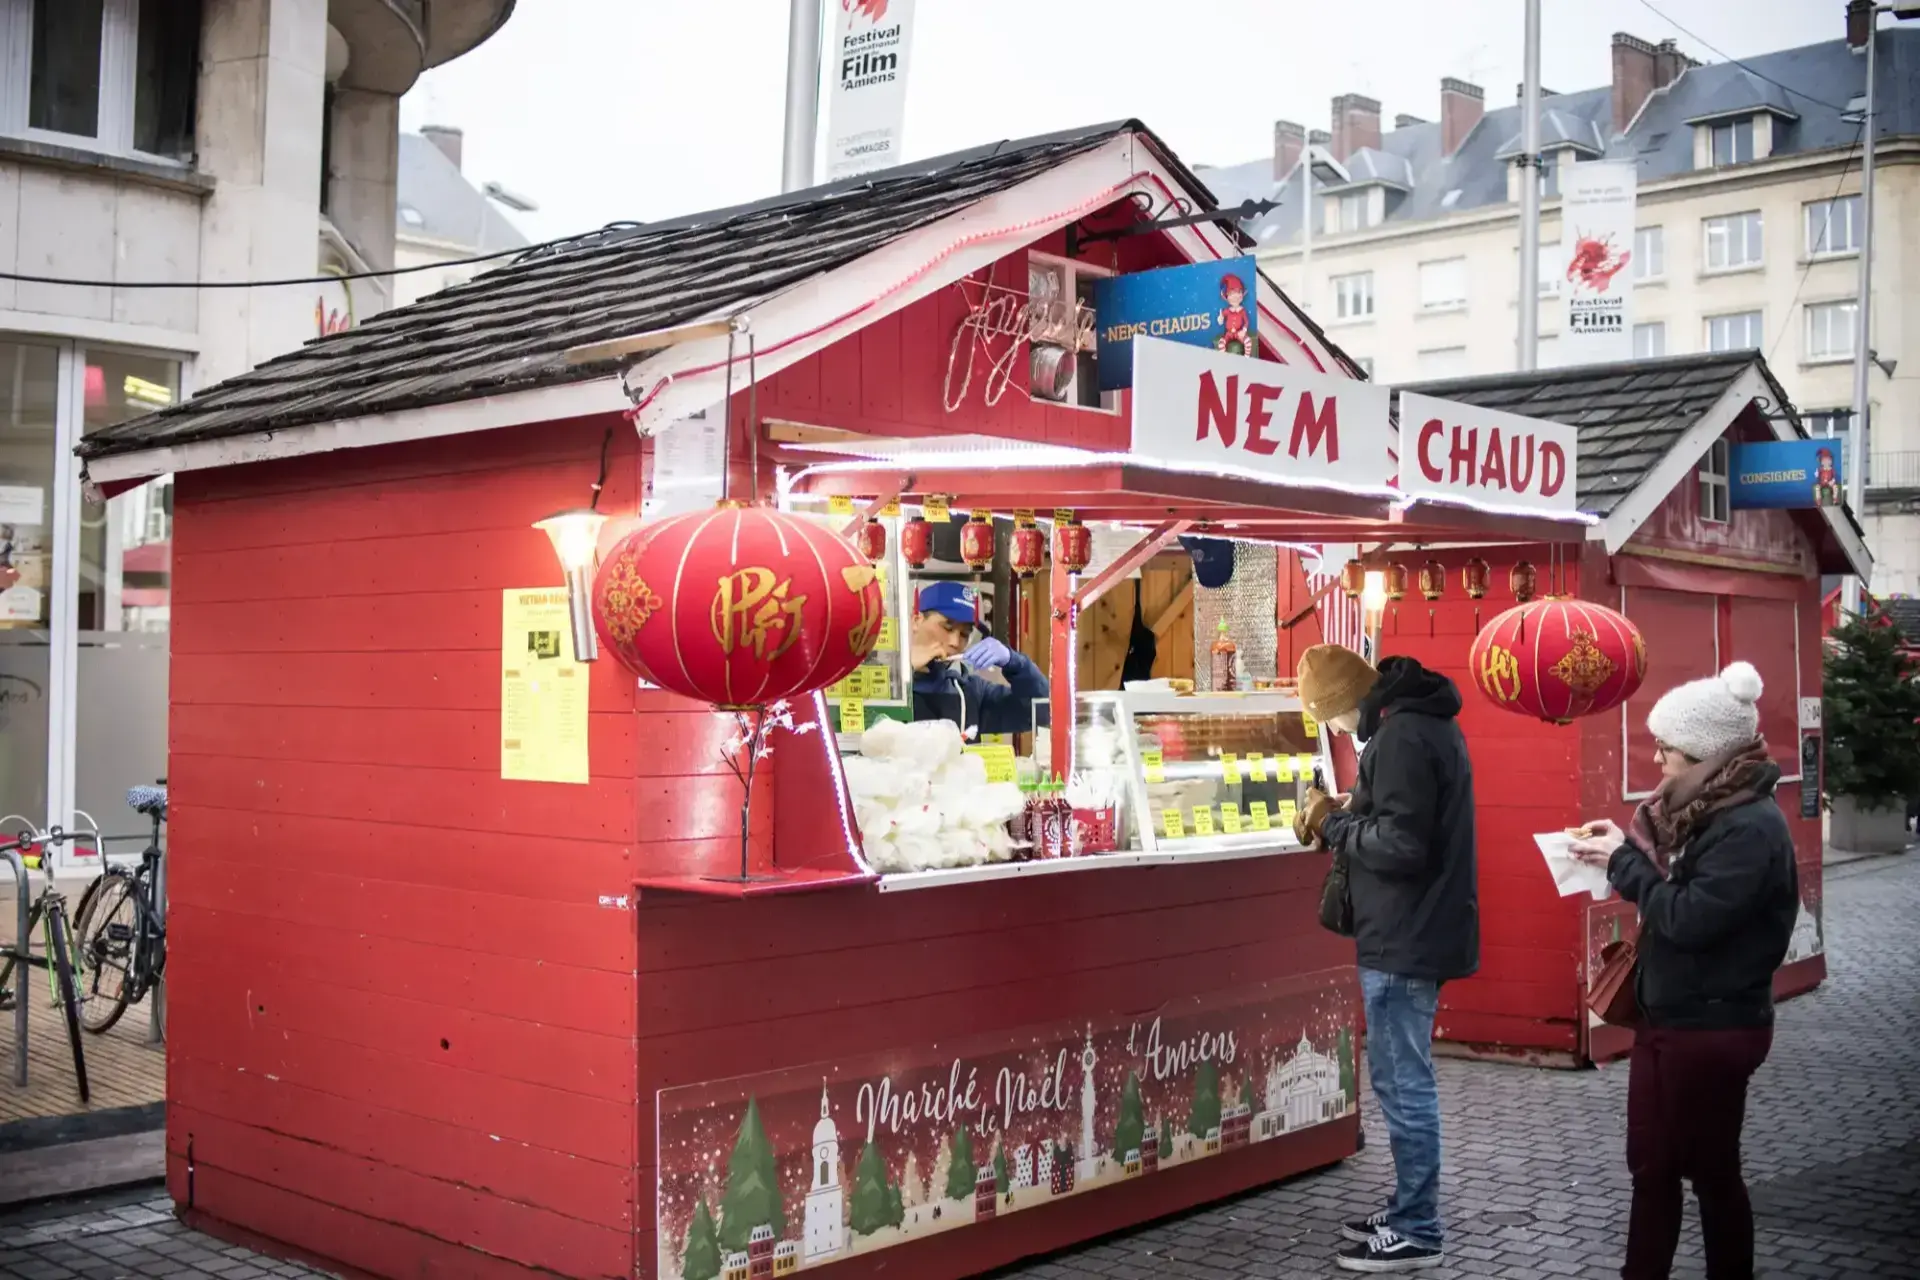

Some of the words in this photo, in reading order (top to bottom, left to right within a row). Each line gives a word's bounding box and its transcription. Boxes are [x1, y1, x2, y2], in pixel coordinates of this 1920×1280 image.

[843, 24, 900, 48] Festival
[841, 52, 897, 81] Film
[1570, 296, 1623, 307] Festival
[1108, 323, 1147, 343] NEMS
[1151, 312, 1211, 336] CHAUDS
[1570, 312, 1623, 327] Film
[1195, 369, 1339, 465] NEM
[1417, 419, 1566, 498] CHAUD
[1740, 469, 1806, 485] CONSIGNES
[856, 1058, 980, 1144] Marché
[995, 1048, 1072, 1130] Noël
[1126, 1015, 1239, 1082] d'Amiens
